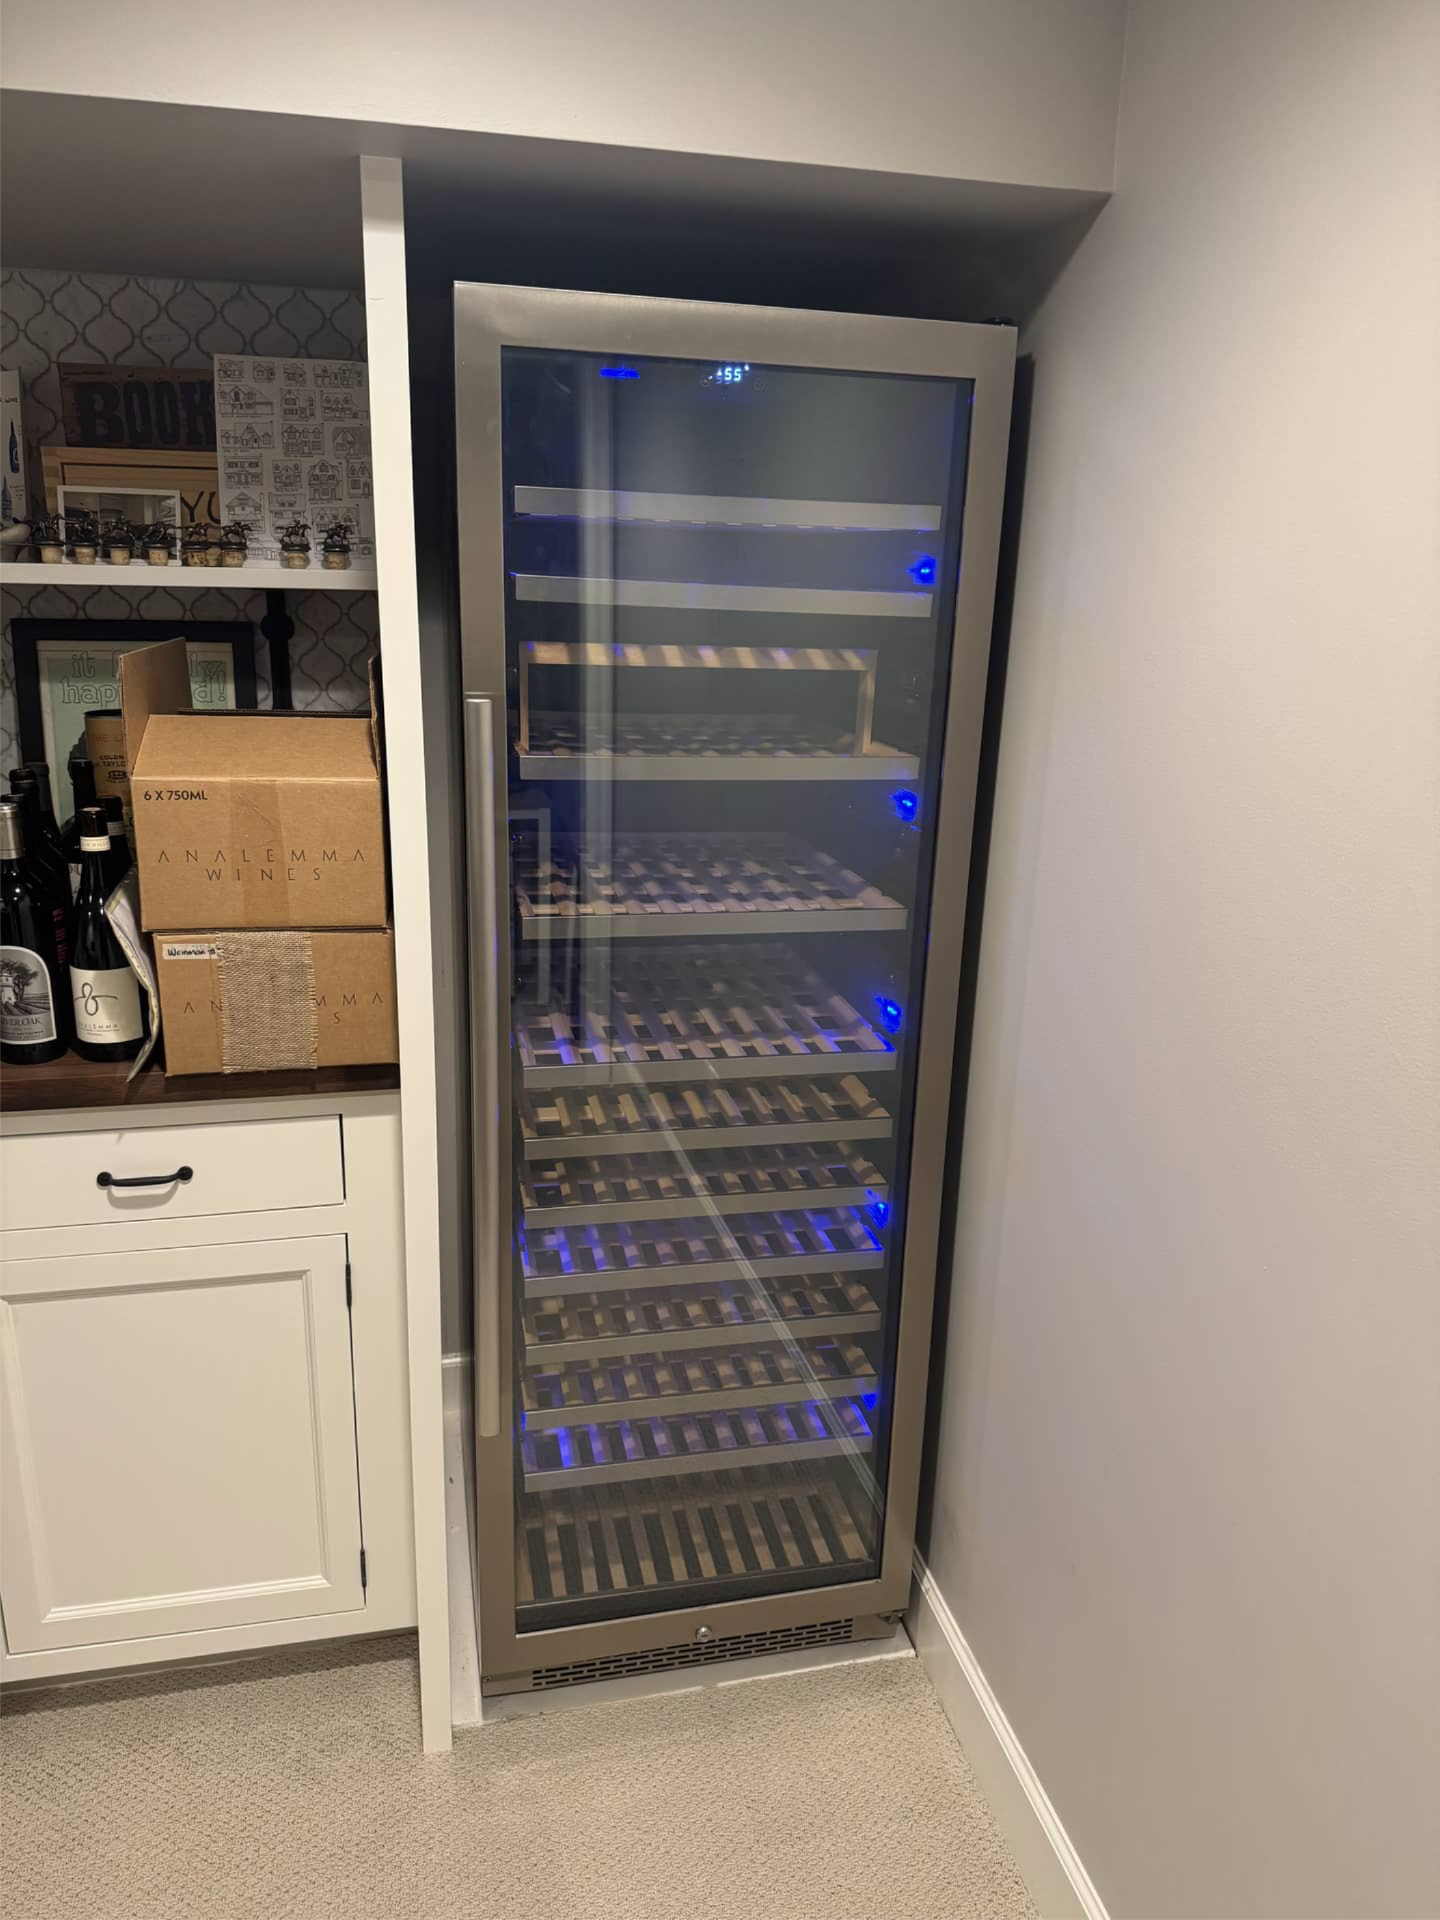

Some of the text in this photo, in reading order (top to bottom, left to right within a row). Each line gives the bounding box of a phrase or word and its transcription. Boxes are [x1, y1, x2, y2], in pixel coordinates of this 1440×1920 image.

[72, 650, 96, 679] it
[144, 790, 208, 801] 6 X 750ML
[206, 867, 322, 881] WINES
